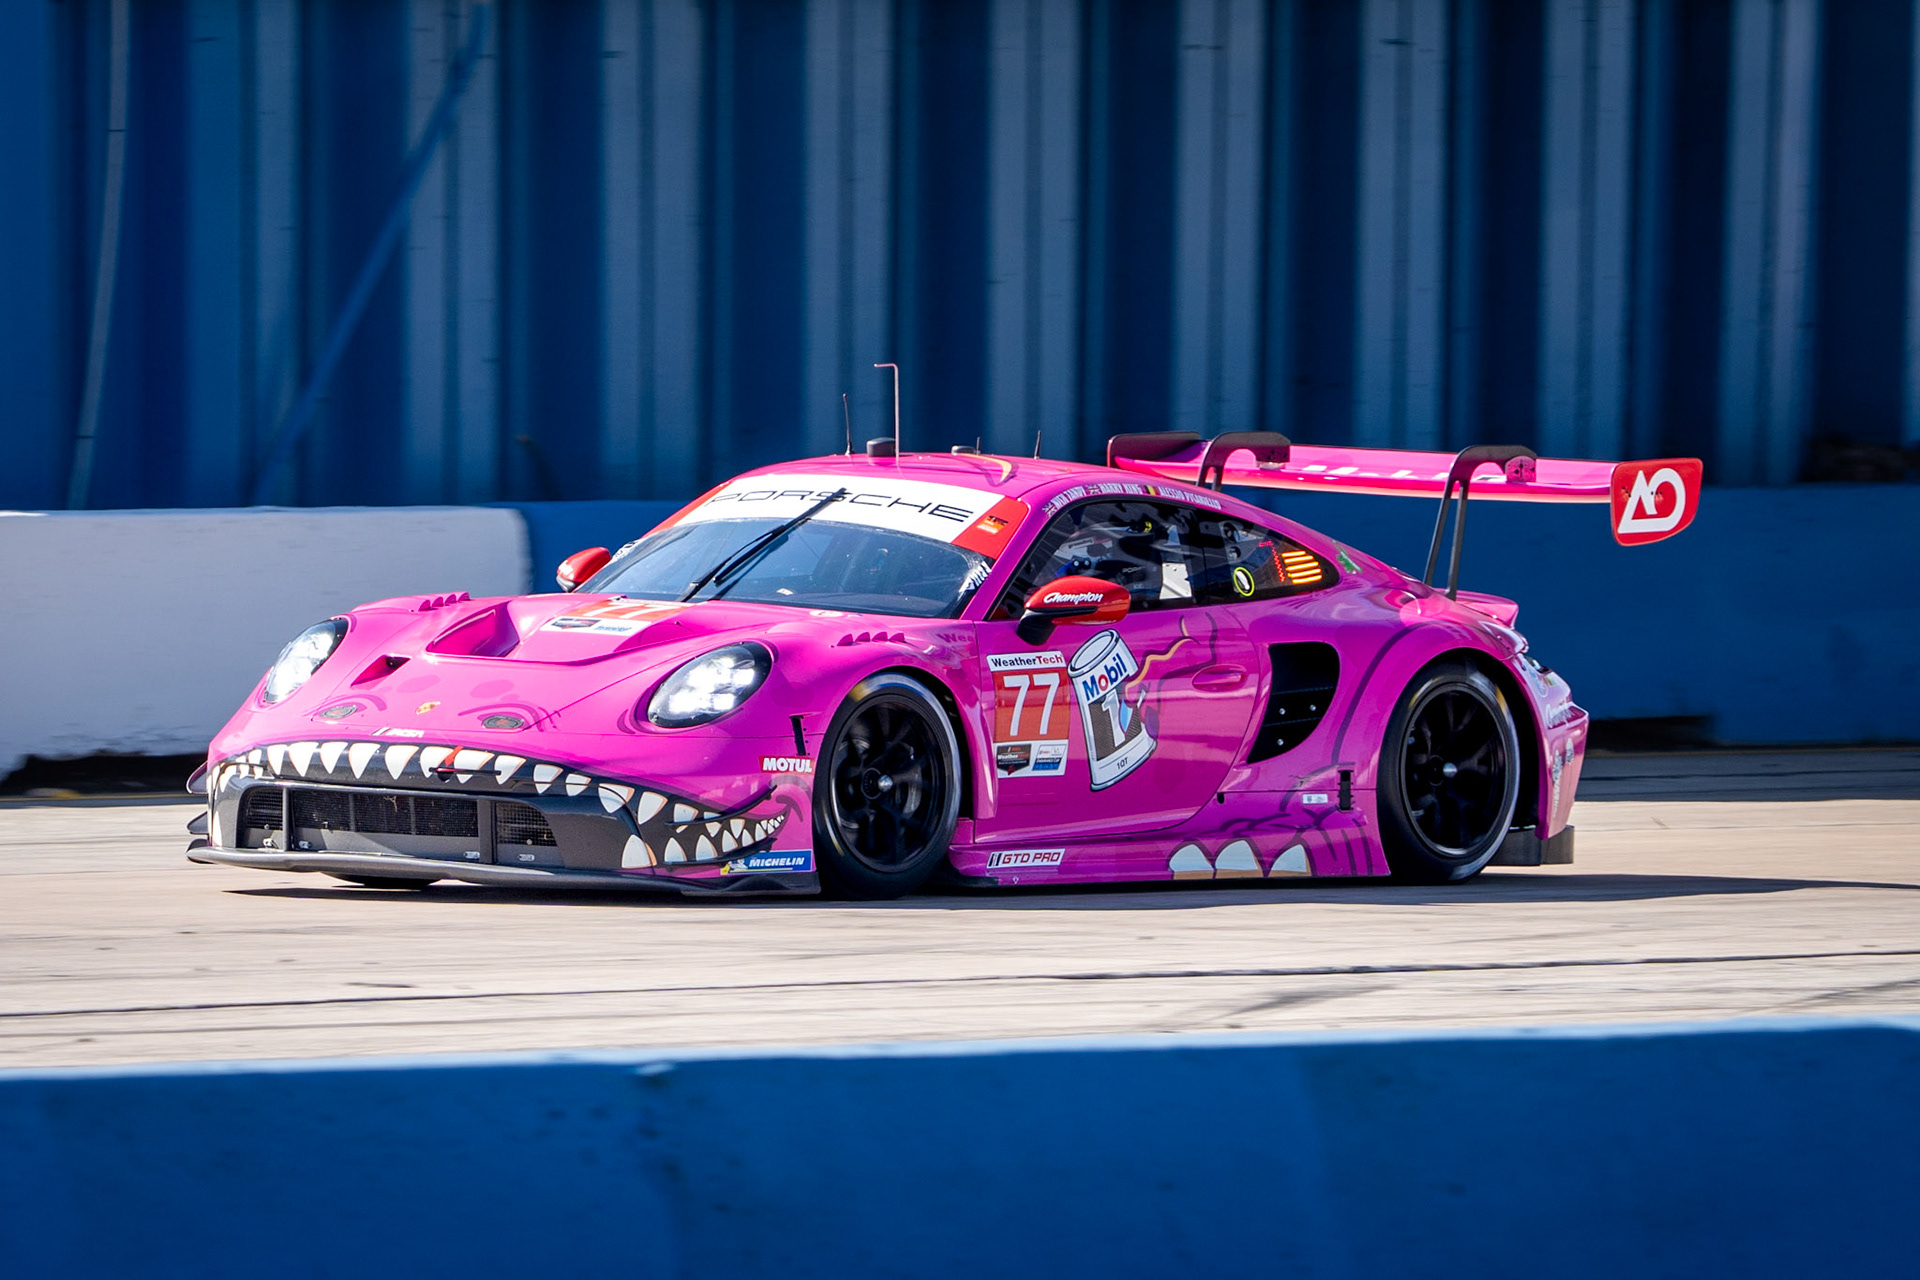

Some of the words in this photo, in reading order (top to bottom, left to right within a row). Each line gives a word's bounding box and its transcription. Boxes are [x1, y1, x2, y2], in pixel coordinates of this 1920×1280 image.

[704, 489, 975, 523] PORSCHE
[1043, 591, 1104, 605] Champion
[583, 602, 681, 618] 77
[991, 654, 1063, 667] WeatherTech
[1082, 652, 1128, 701] Mobil
[1003, 672, 1061, 737] 77
[762, 757, 813, 773] MOTUL
[748, 857, 806, 868] MICHELIN
[1002, 853, 1031, 865] GTD
[1032, 851, 1062, 863] PRO
